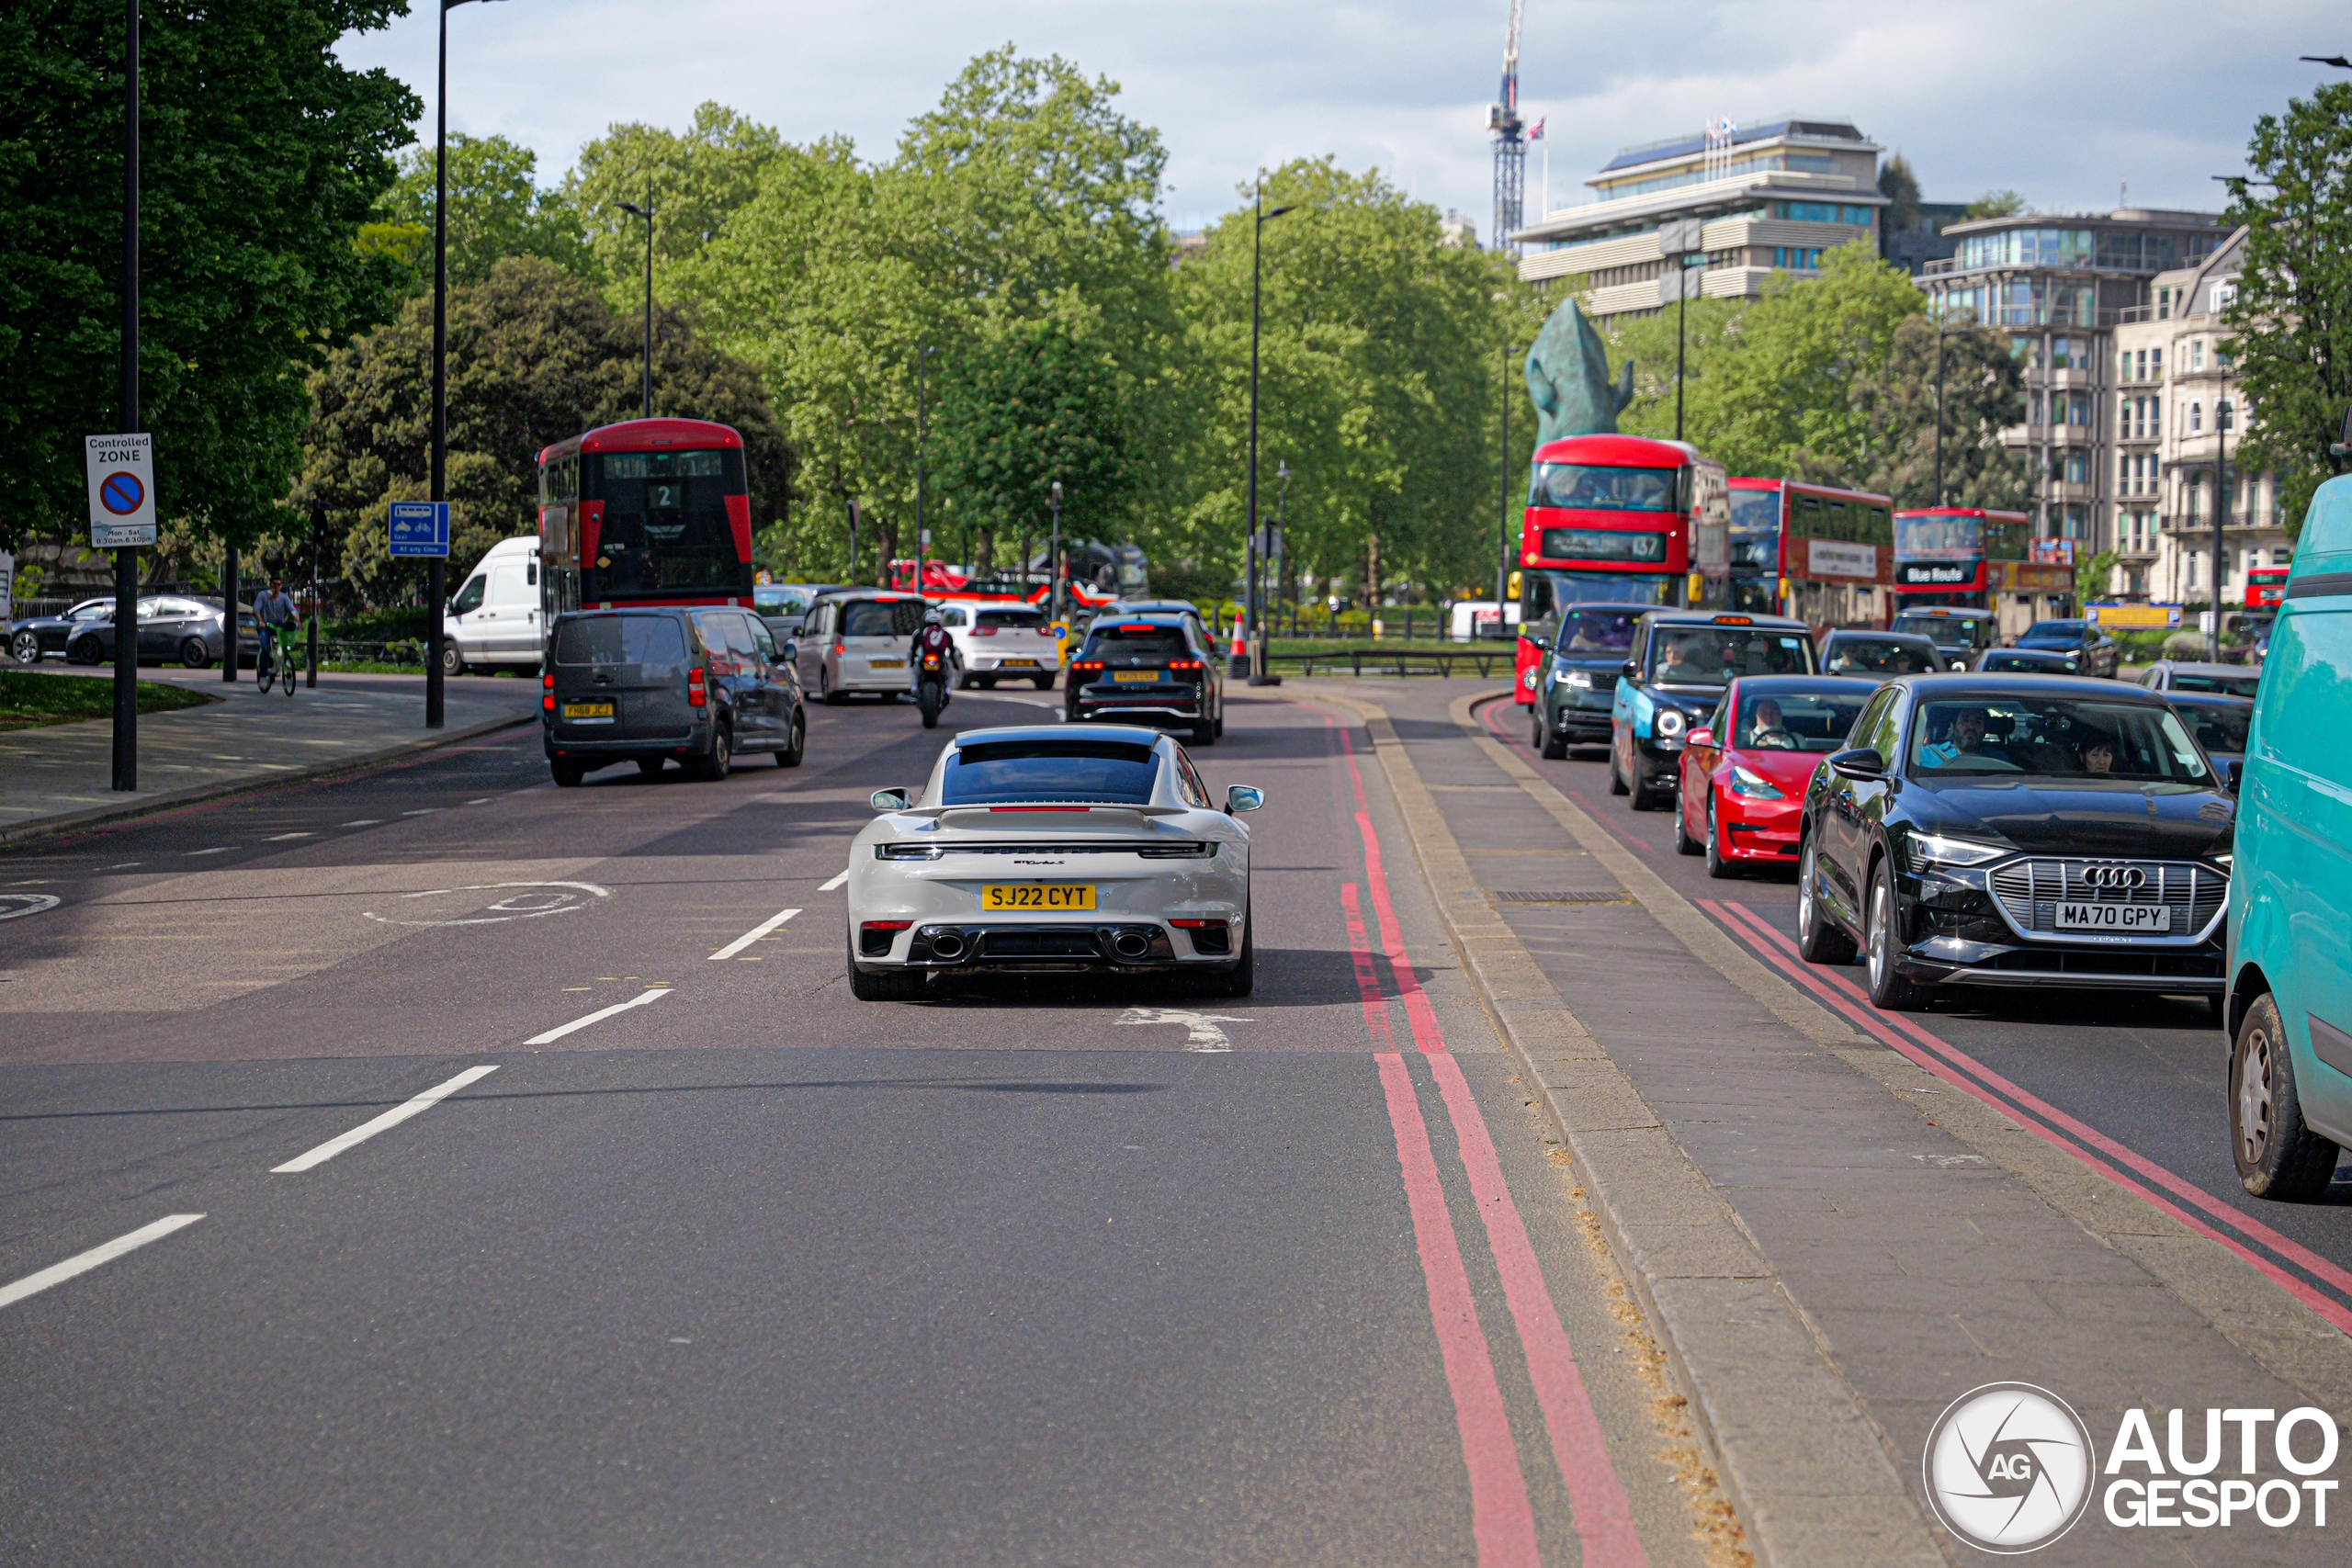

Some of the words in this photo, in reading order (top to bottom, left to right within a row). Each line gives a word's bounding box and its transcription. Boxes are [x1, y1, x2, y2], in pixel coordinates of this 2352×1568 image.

[89, 437, 149, 449] Controlled
[98, 450, 141, 462] ZONE
[658, 486, 671, 506] 2
[1633, 536, 1658, 557] 137
[991, 887, 1043, 906] SJ22
[1048, 887, 1087, 906] CYT
[2064, 906, 2117, 925] MA70
[2122, 908, 2161, 926] GPY
